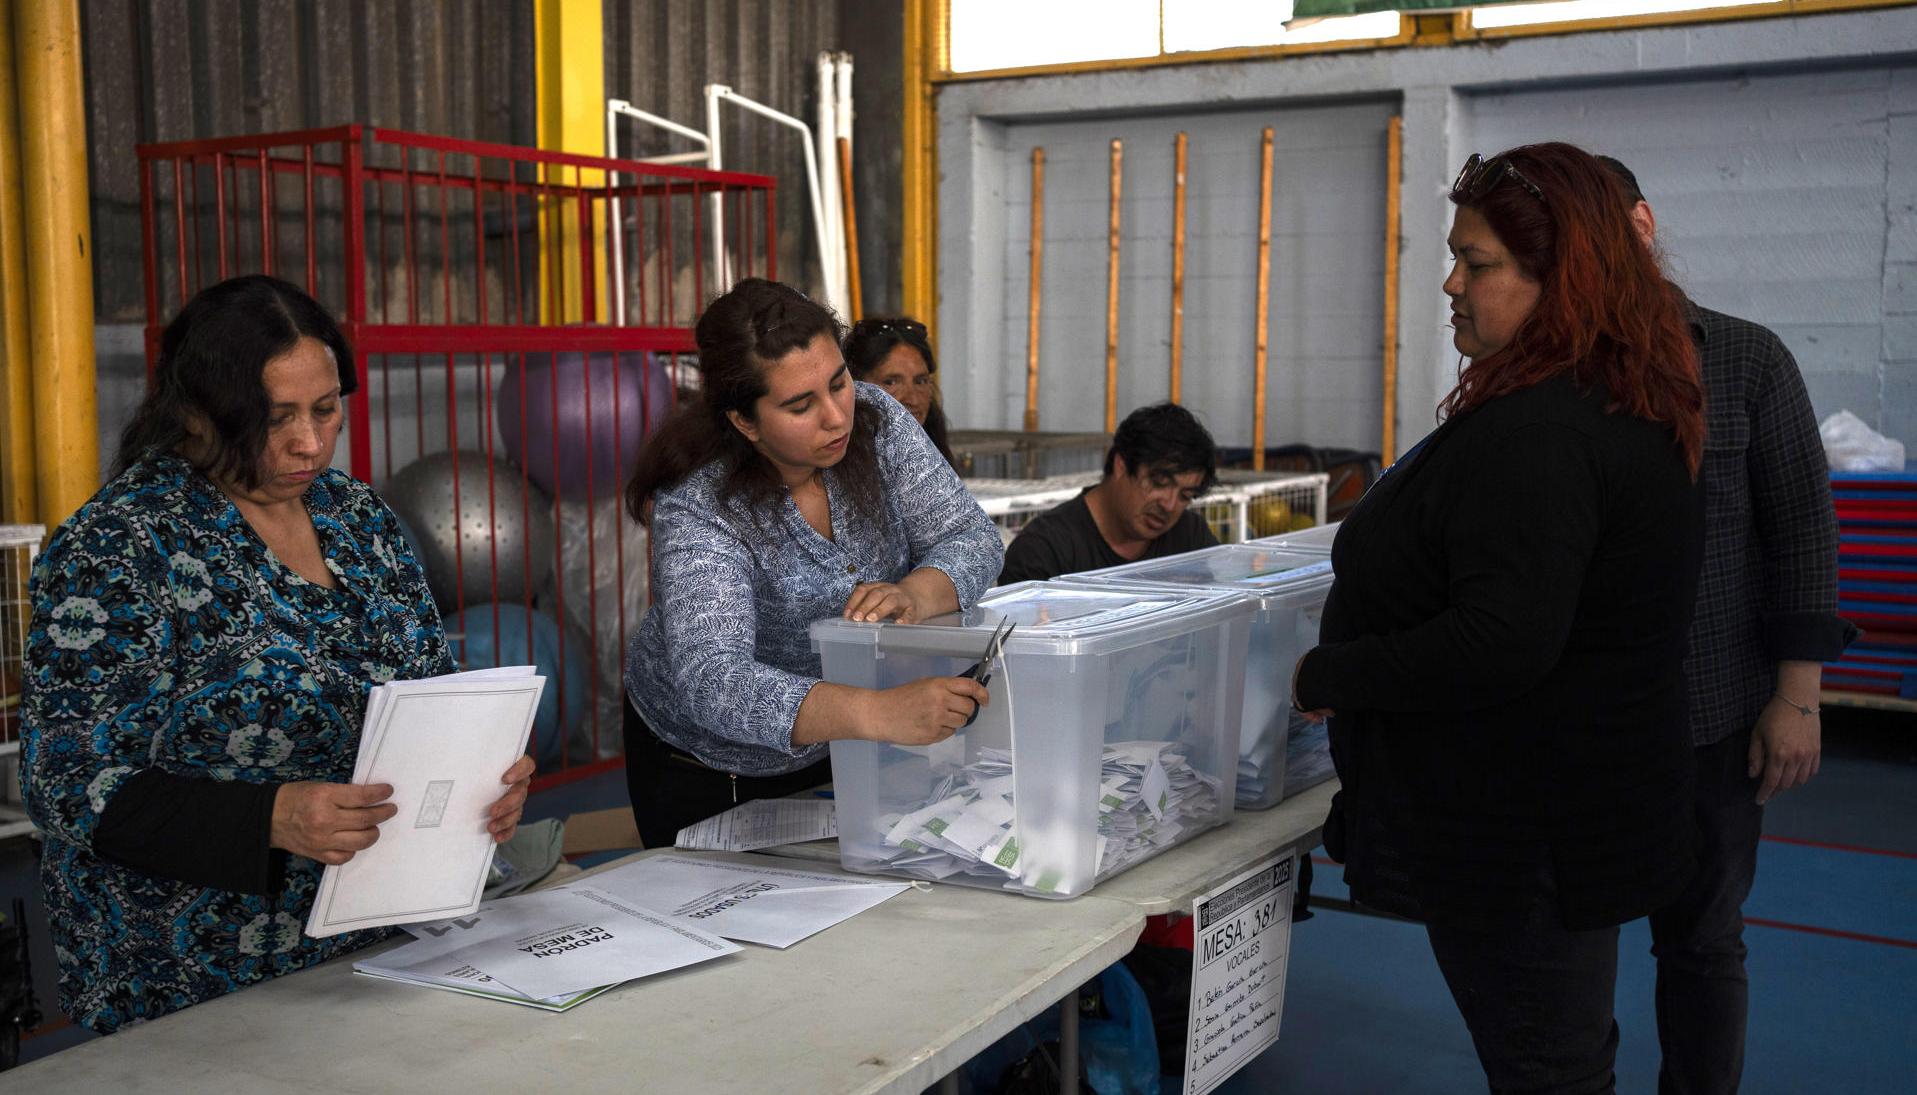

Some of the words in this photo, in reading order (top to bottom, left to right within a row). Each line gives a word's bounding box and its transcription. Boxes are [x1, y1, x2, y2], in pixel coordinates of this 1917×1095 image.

[575, 926, 605, 938] DE
[1203, 918, 1246, 965] MESA:
[1252, 900, 1277, 937] 381
[517, 934, 576, 953] MESA
[533, 932, 614, 958] PADRÓN
[1226, 940, 1260, 973] VOCALES
[1195, 1018, 1201, 1033] 2
[1193, 1038, 1199, 1054] 3
[1191, 1058, 1197, 1073] 4
[1189, 1079, 1196, 1095] 5
